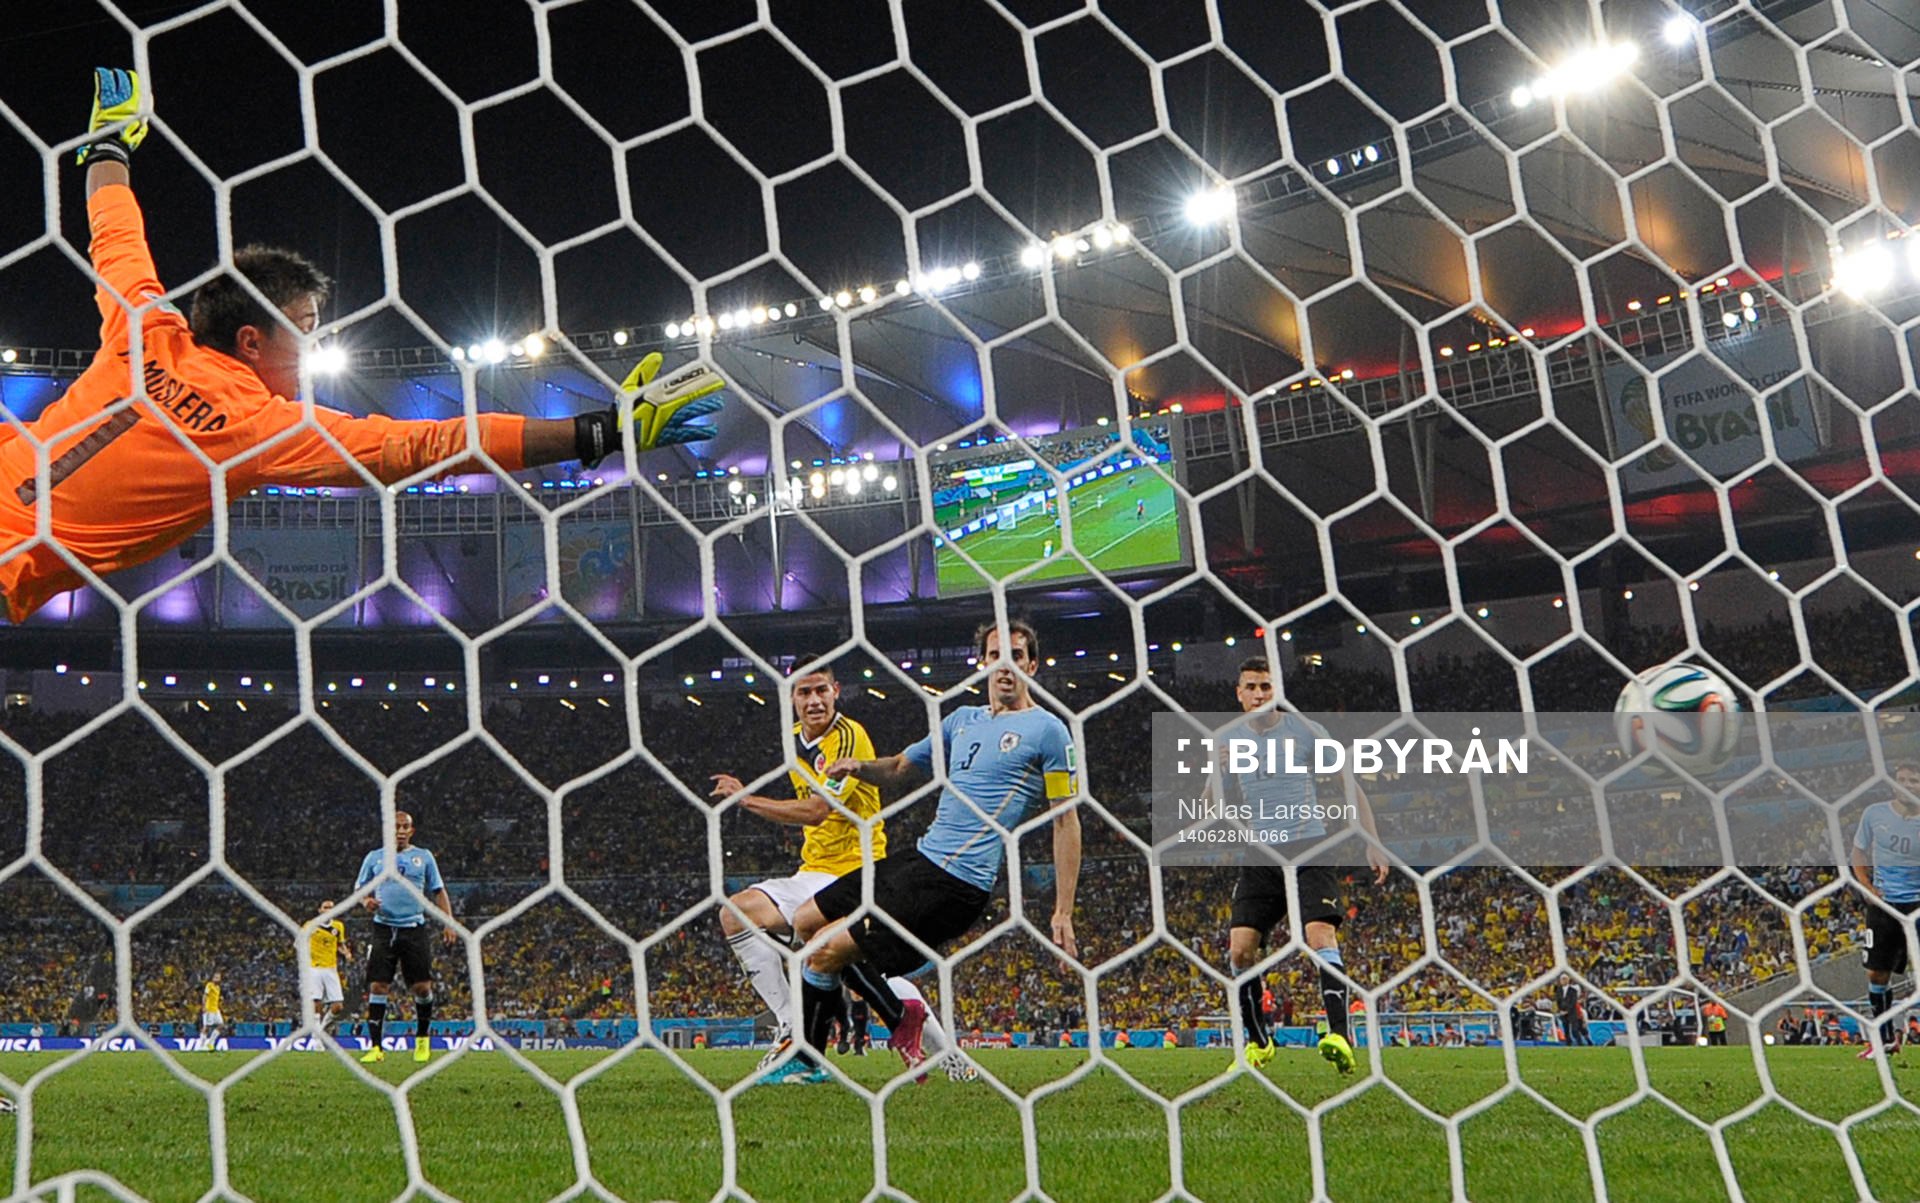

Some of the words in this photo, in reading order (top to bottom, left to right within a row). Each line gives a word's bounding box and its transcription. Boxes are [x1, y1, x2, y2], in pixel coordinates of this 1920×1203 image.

[144, 360, 227, 432] MUSLERA
[1673, 391, 1705, 408] FIFA
[1705, 378, 1760, 400] WORD
[961, 742, 981, 770] 3
[1889, 834, 1911, 855] 20
[0, 1038, 41, 1051] ISA
[174, 1038, 230, 1051] VIA
[355, 1038, 408, 1052] VSA
